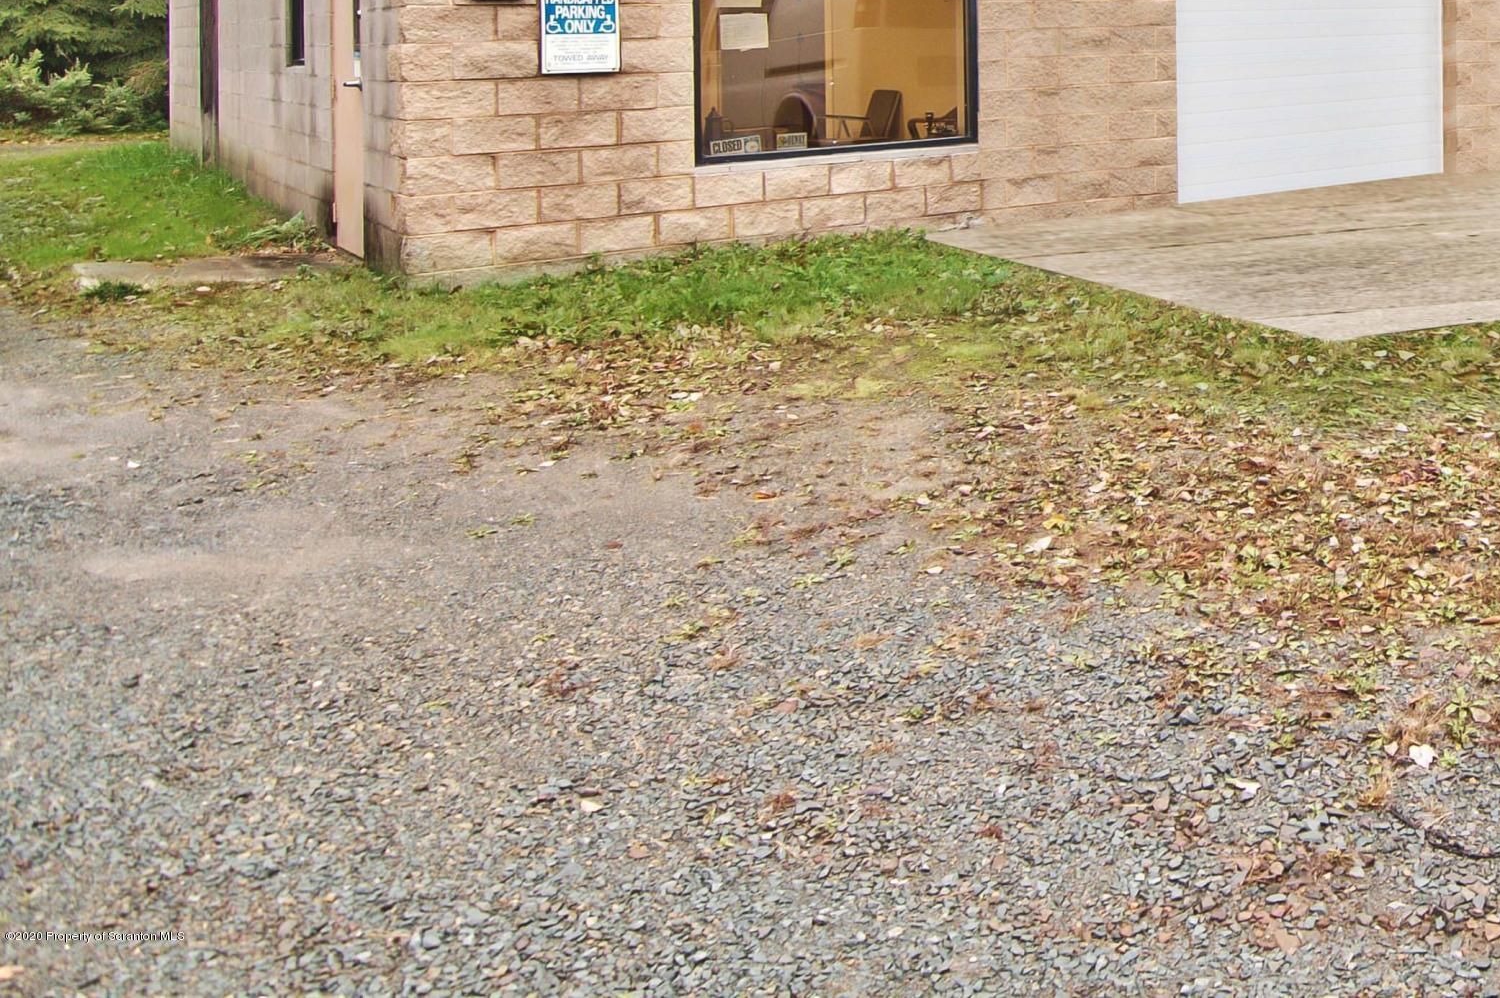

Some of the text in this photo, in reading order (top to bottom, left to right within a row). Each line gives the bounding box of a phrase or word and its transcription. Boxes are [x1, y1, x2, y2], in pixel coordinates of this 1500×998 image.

[555, 5, 605, 19] PARKING
[564, 19, 596, 33] ONLY
[712, 139, 743, 154] CLOSED
